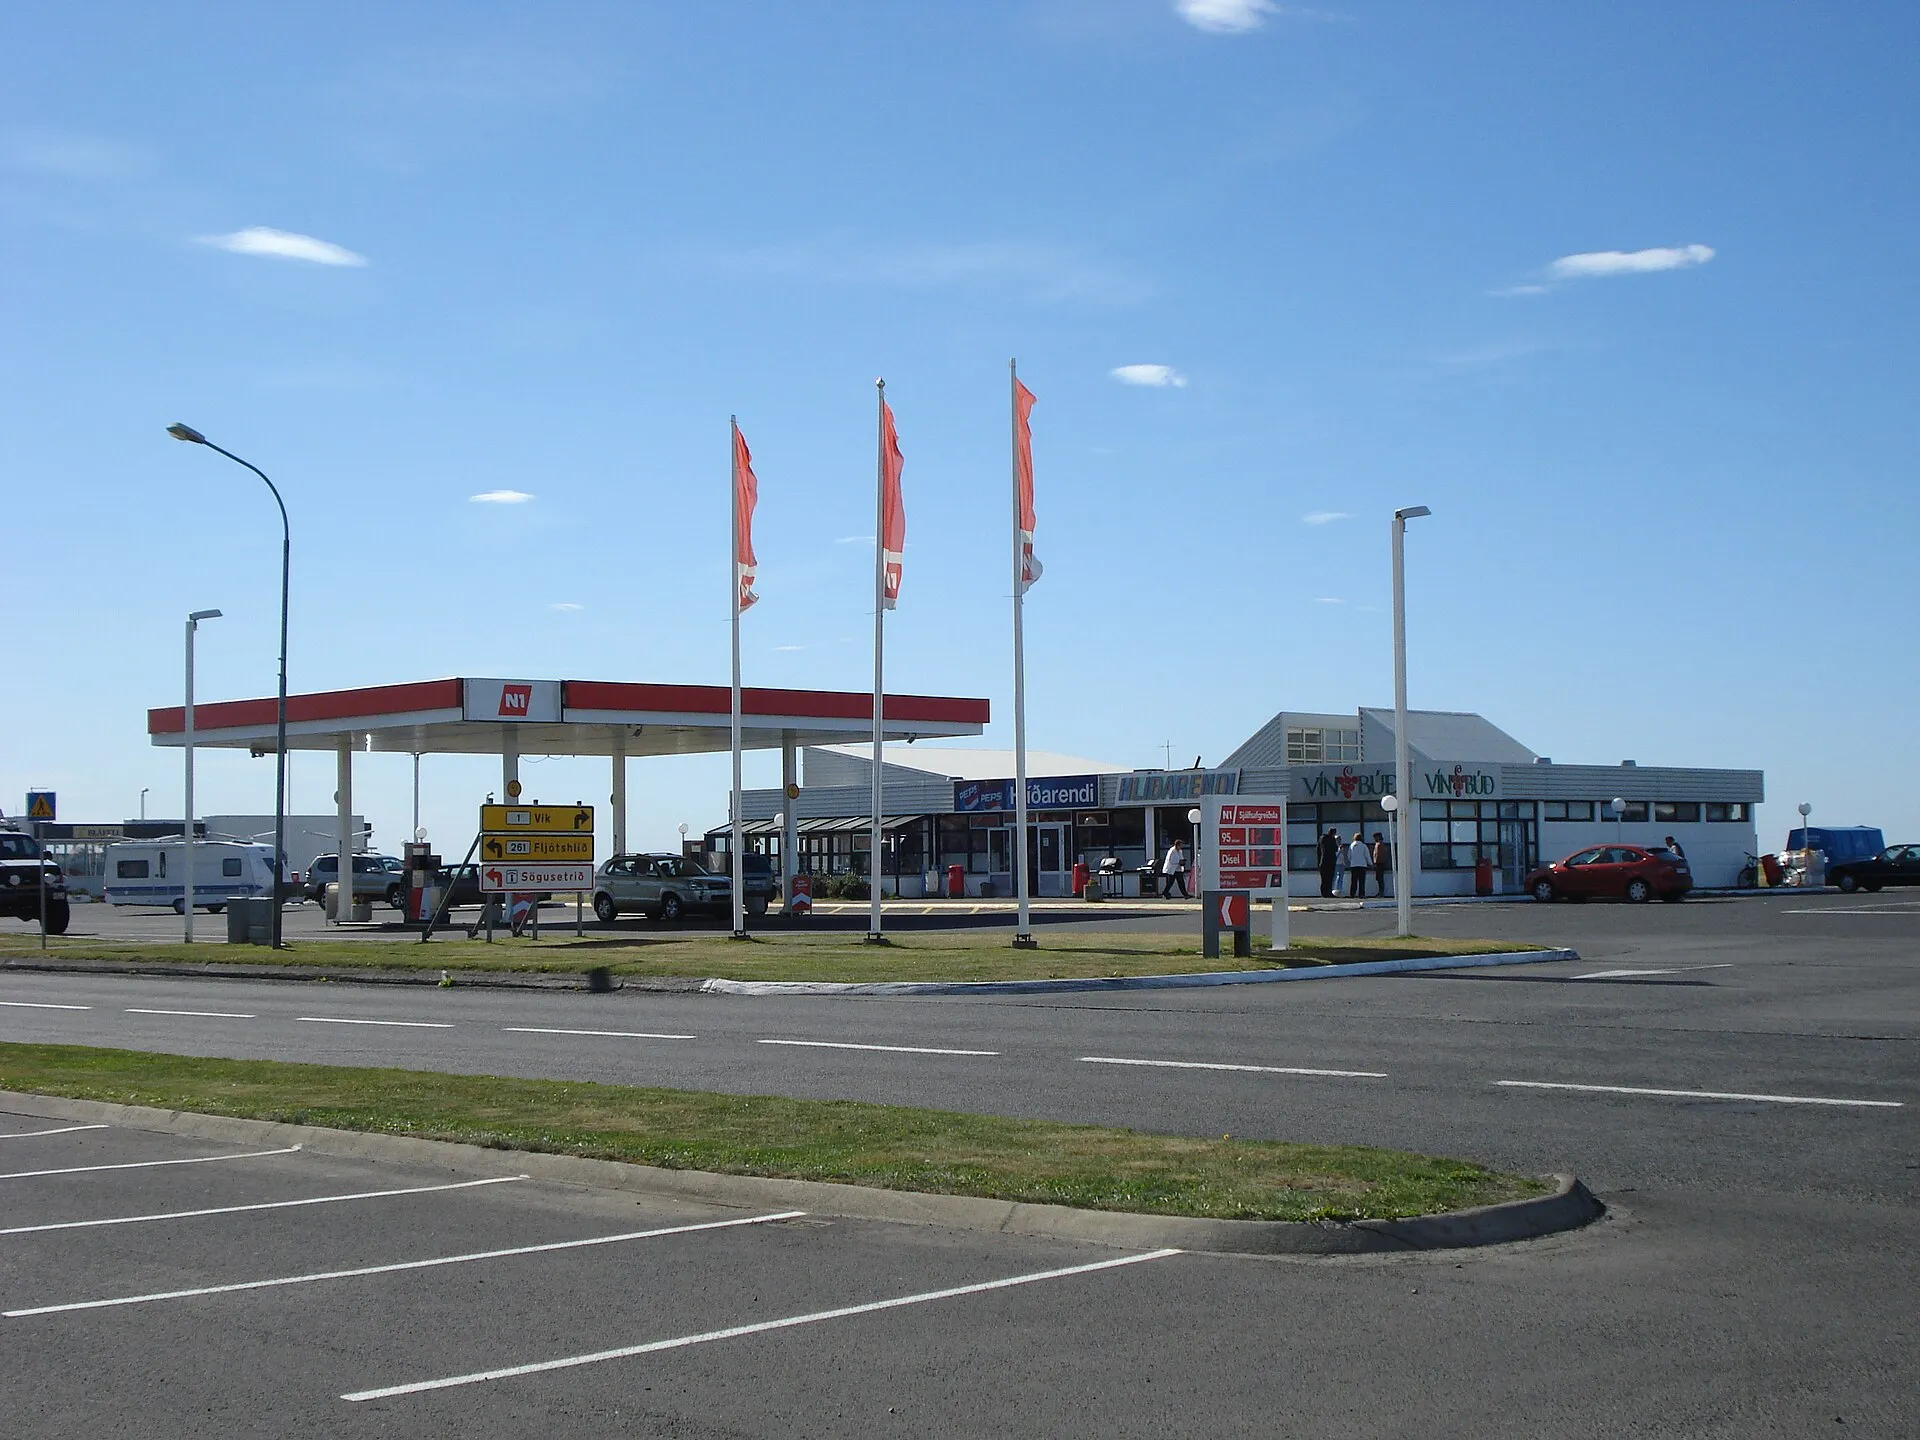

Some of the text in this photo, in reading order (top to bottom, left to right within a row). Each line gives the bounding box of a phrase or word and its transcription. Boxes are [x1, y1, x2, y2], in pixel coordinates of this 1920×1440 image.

[505, 693, 525, 708] N1
[1302, 771, 1339, 796] VÍN
[1425, 768, 1452, 794] VÍN
[981, 792, 1003, 802] PEPSI
[1010, 783, 1095, 805] Híðarendi
[1222, 811, 1233, 820] N1
[1221, 832, 1231, 843] 95
[510, 843, 527, 852] 261
